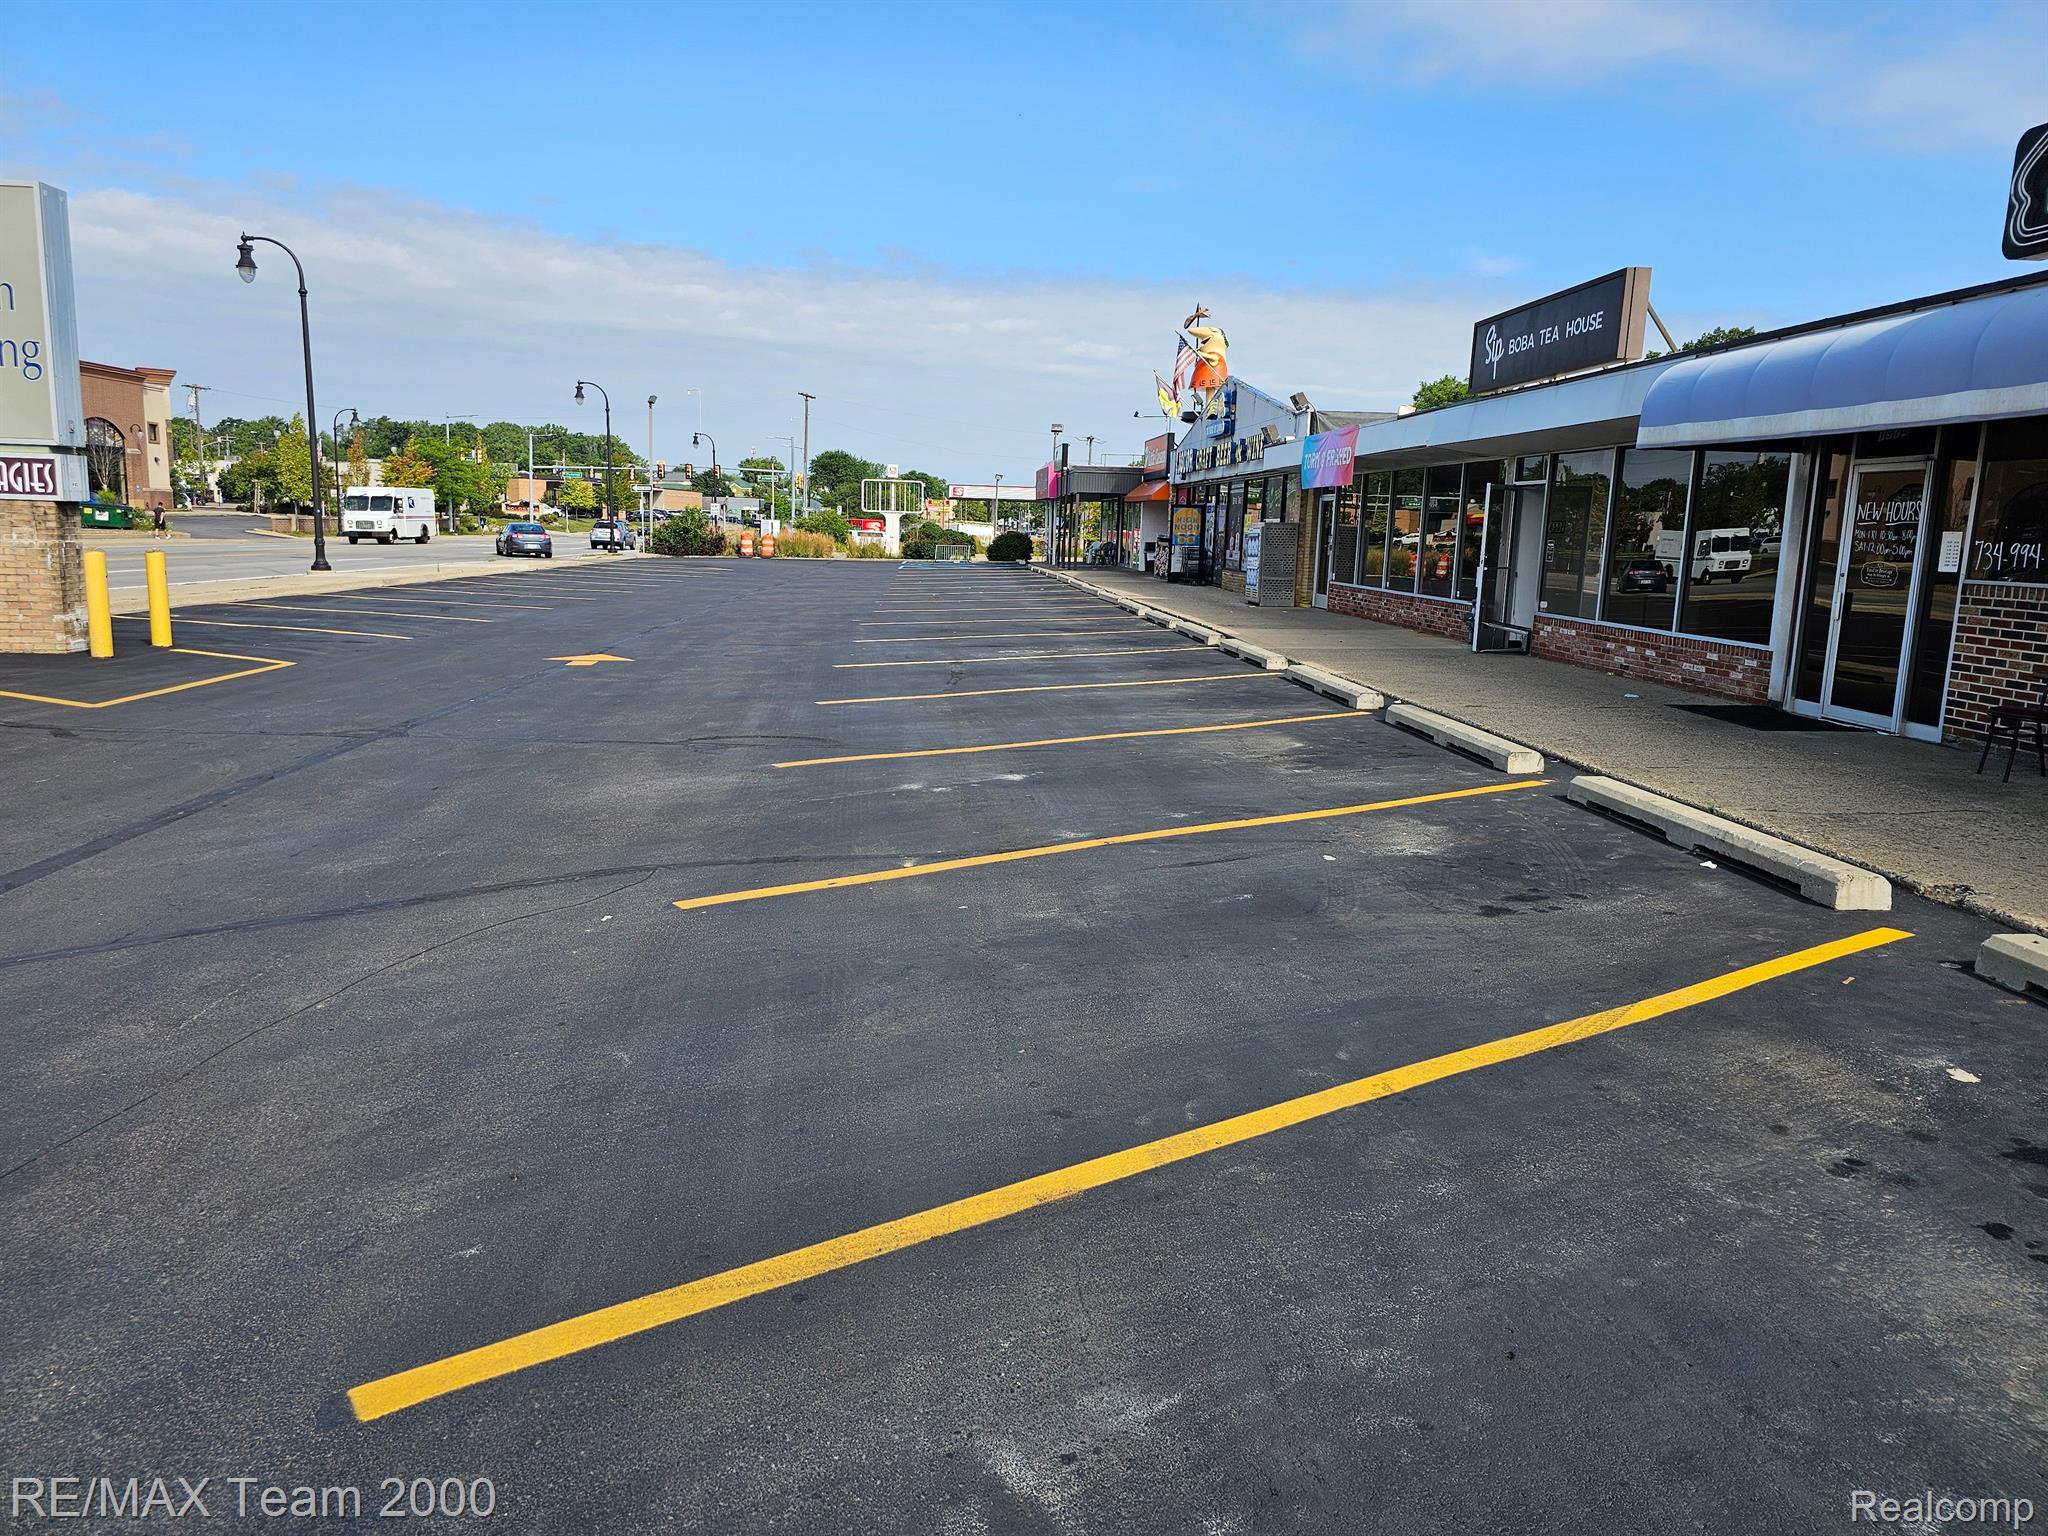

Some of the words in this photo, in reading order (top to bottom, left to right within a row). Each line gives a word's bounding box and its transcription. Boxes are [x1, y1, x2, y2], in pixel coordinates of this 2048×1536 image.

[1485, 324, 1504, 380] Sip
[1508, 333, 1535, 355] BOBA
[1539, 325, 1559, 346] TEA
[1565, 311, 1604, 338] HOUSE
[1196, 446, 1213, 472] CRAFT
[1215, 441, 1232, 467] BEER
[1246, 433, 1265, 461] WINE
[1857, 501, 1885, 521] NEW
[1885, 501, 1922, 522] HOURS
[1174, 523, 1200, 531] NOON
